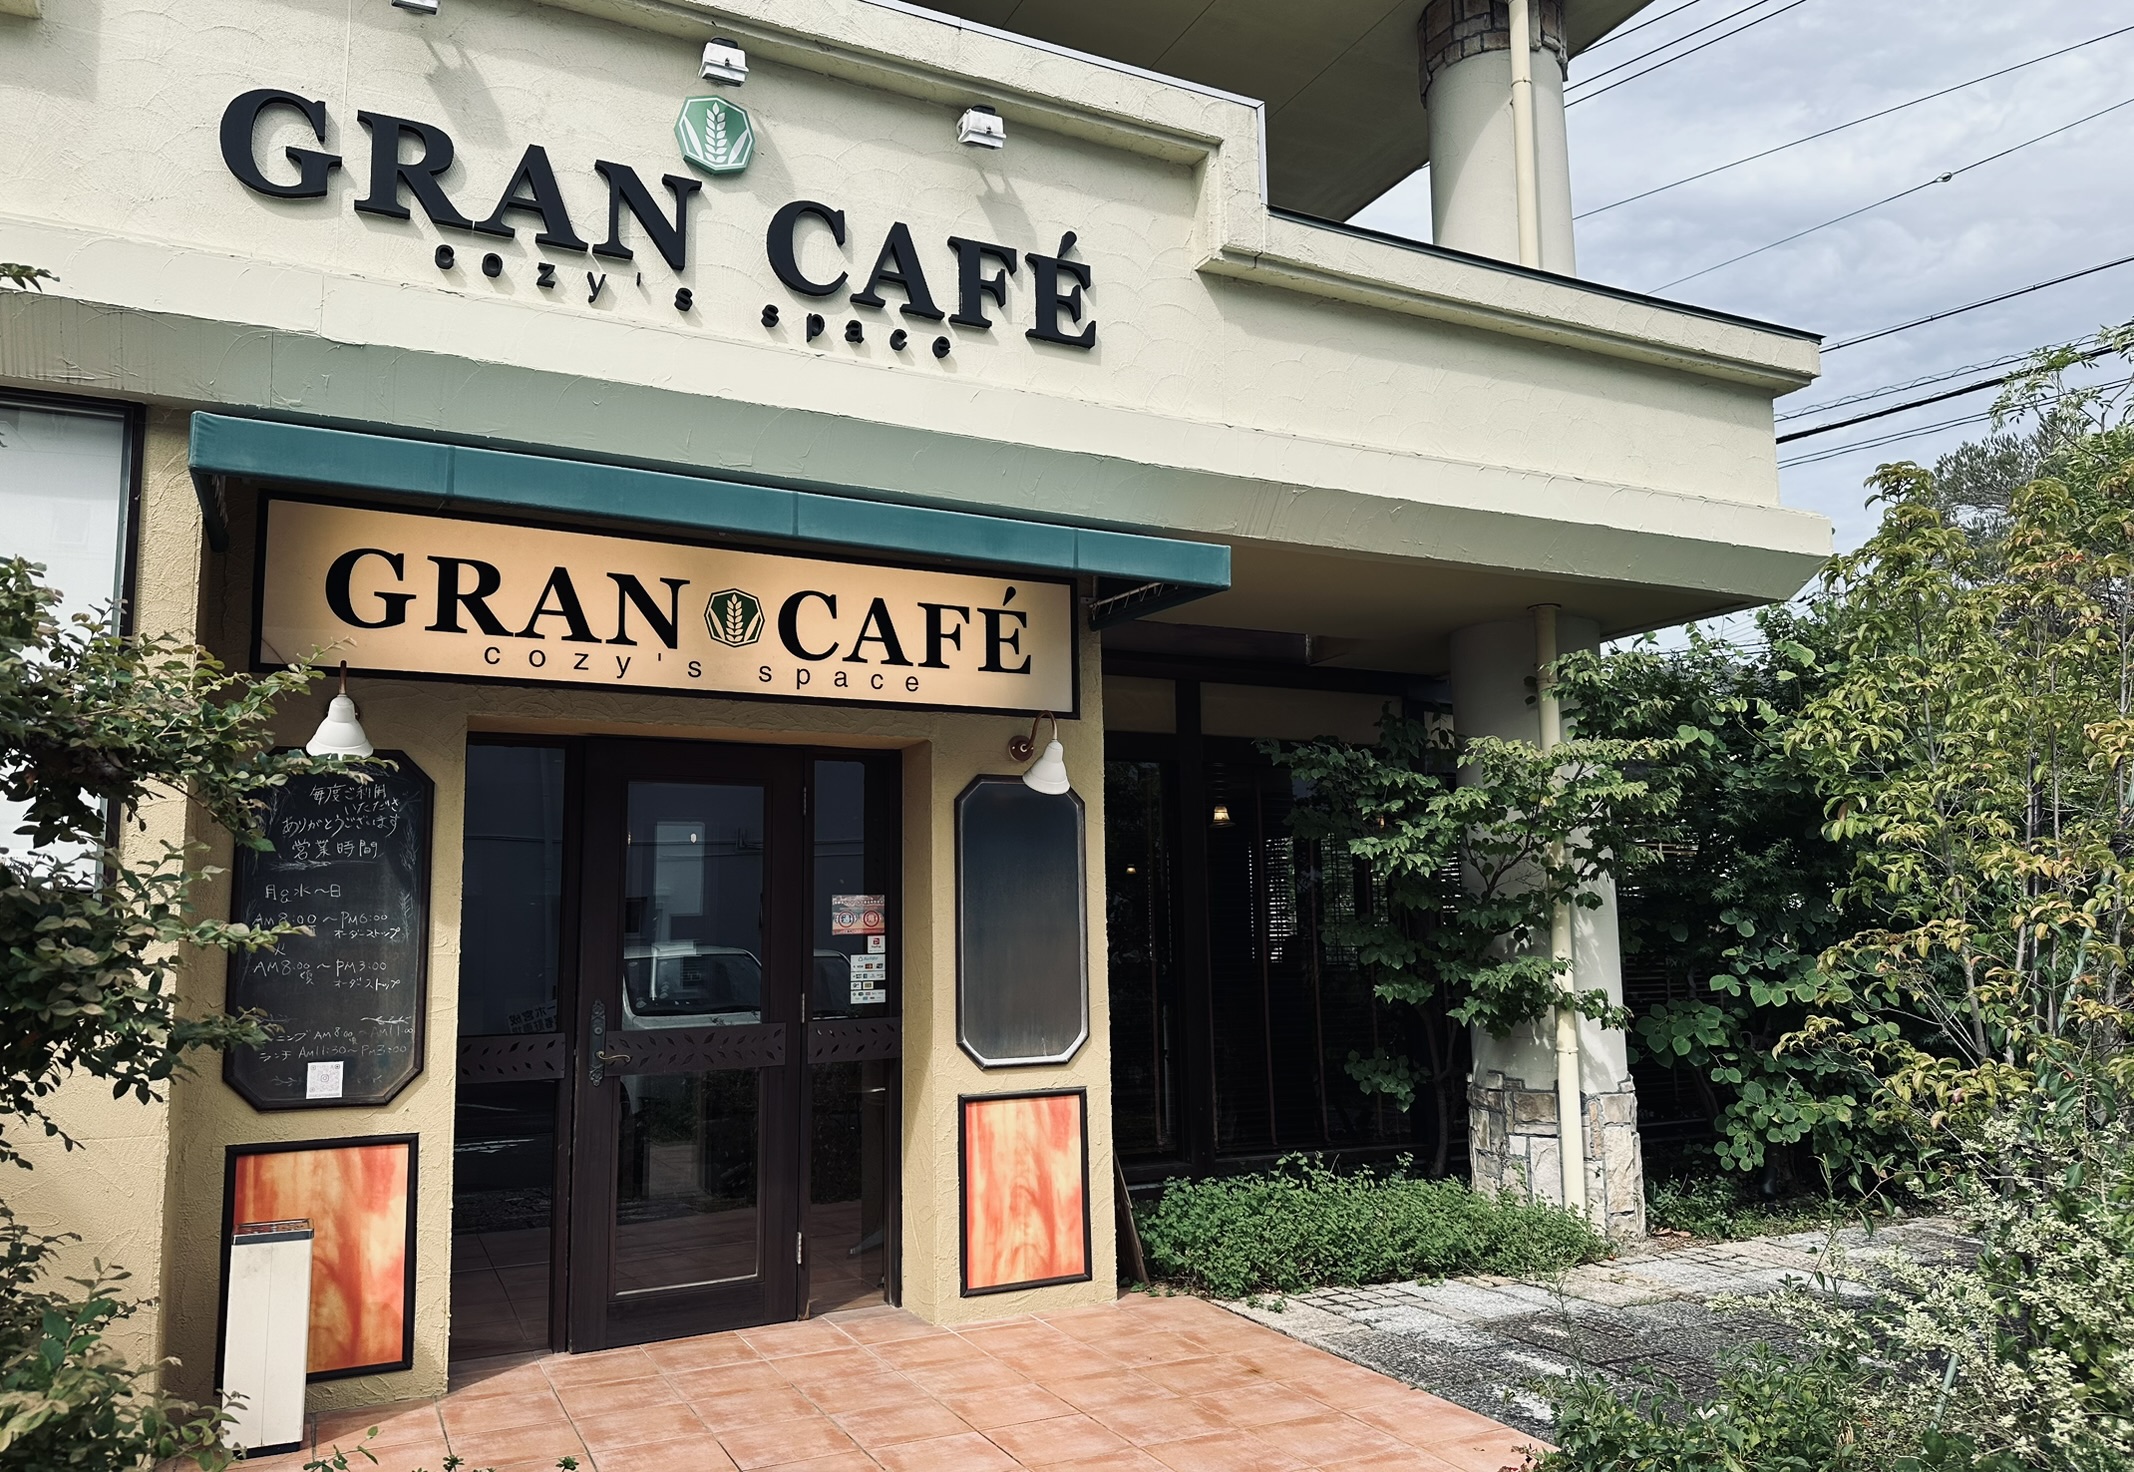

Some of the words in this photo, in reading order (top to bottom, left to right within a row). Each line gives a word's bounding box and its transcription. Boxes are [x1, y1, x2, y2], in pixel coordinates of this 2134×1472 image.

[219, 88, 703, 273] GRAN
[766, 200, 1098, 350] CAFÉ
[434, 244, 694, 313] cozy's
[761, 303, 951, 360] space
[325, 547, 691, 650] GRAN
[777, 585, 1032, 676] CAFÉ
[484, 646, 702, 679] cozy's
[758, 665, 920, 692] space
[281, 813, 401, 838] ありがとうございます
[291, 839, 378, 860] 営業時間
